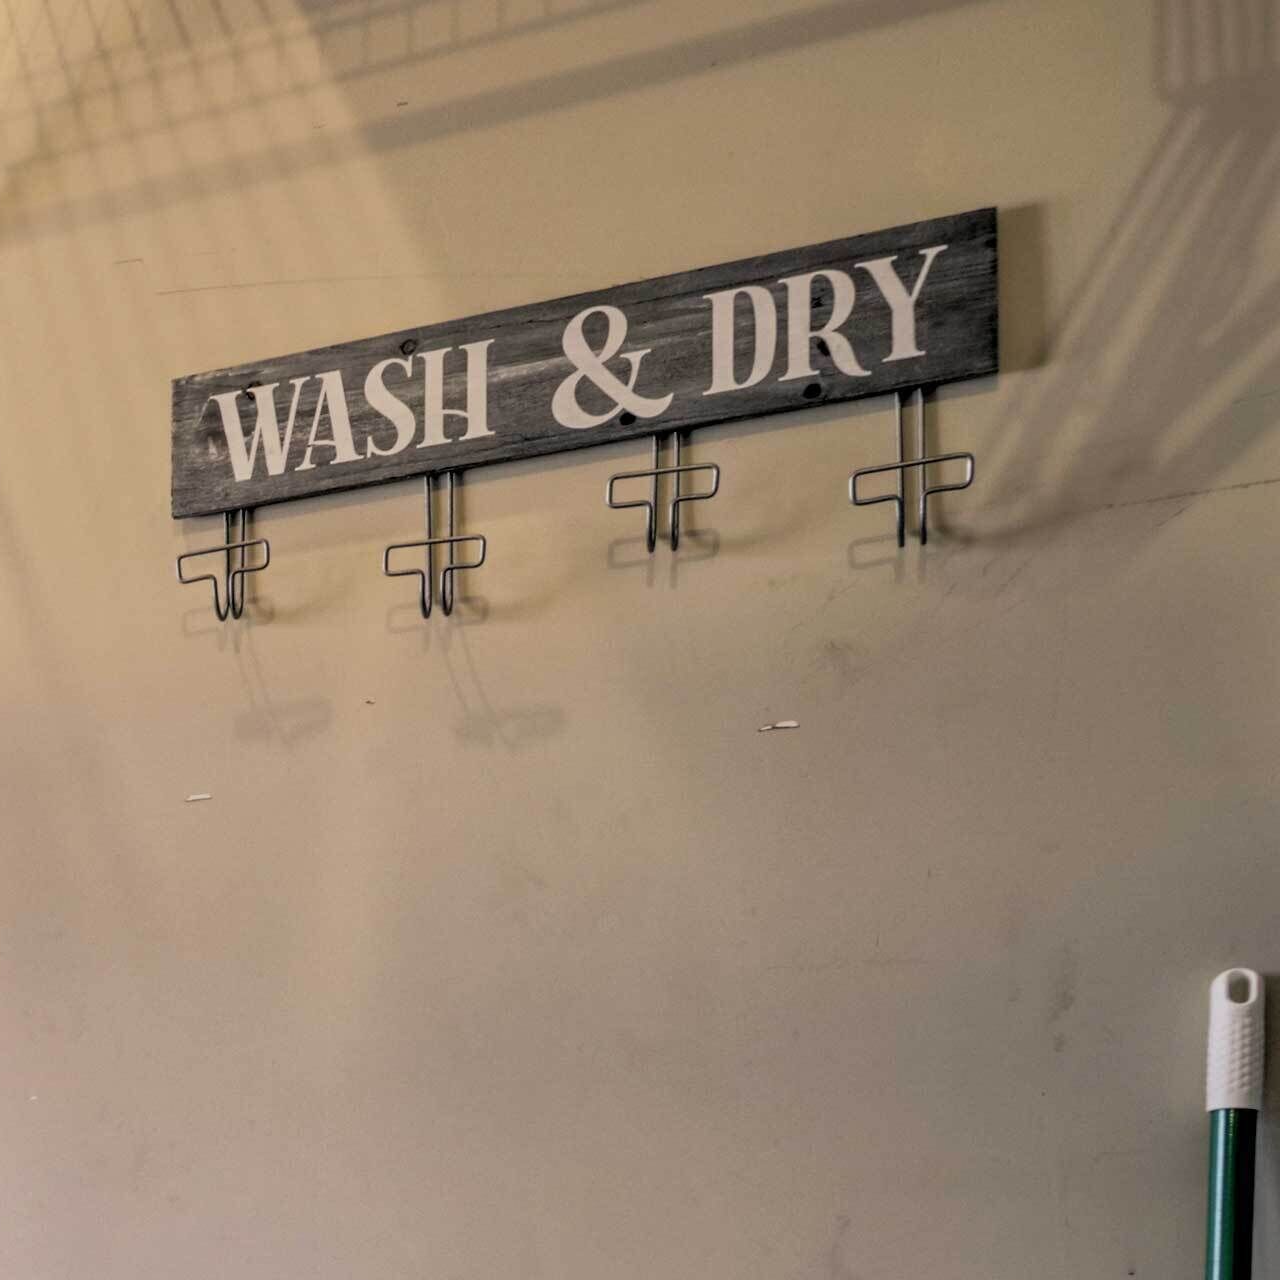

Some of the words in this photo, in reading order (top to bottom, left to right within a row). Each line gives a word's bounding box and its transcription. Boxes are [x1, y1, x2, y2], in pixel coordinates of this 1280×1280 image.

[210, 337, 495, 483] WASH
[551, 304, 673, 430] &
[702, 244, 948, 397] DRY
